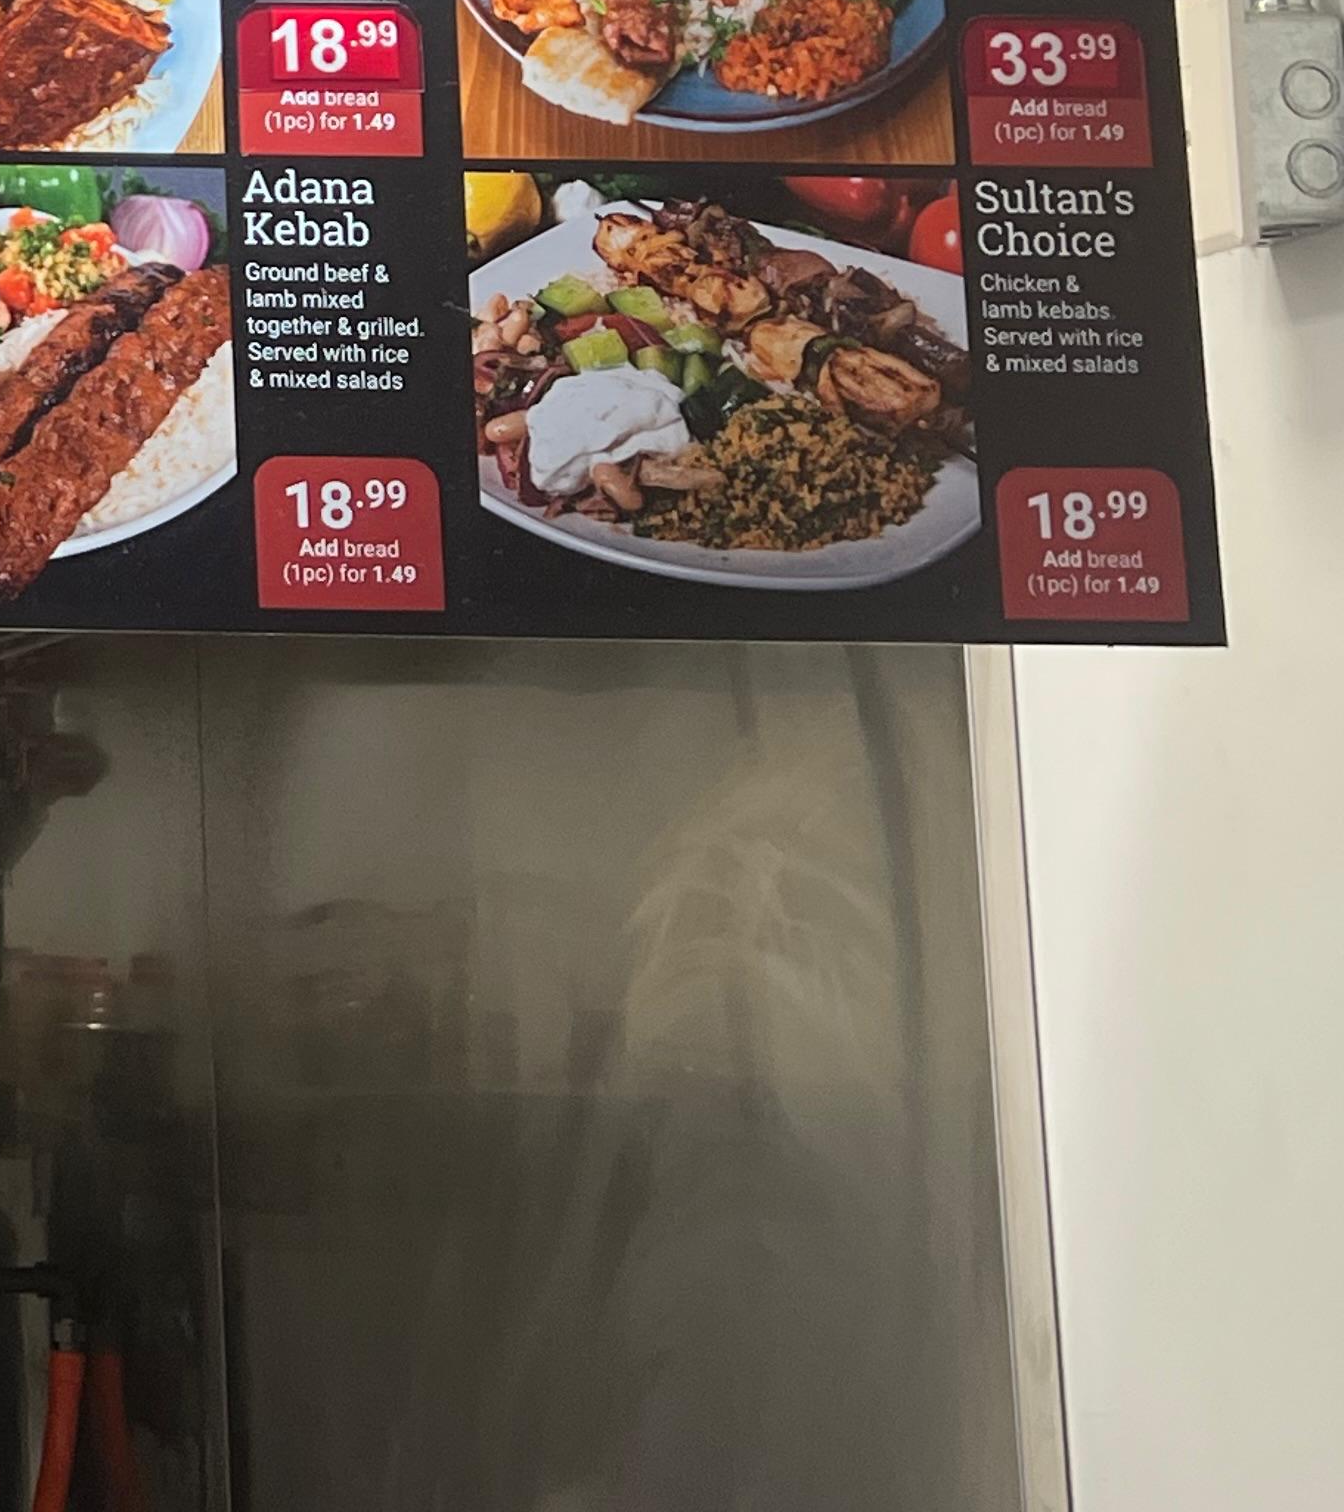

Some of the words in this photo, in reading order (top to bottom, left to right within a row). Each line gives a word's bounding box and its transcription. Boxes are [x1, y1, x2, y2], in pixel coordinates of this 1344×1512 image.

[271, 18, 398, 73] 18.99
[989, 32, 1116, 86] 33.99
[241, 168, 375, 205] Adana
[974, 179, 1135, 215] Sultan's
[242, 210, 370, 247] Kebab
[977, 221, 1116, 258] Choice
[980, 272, 1061, 293] Chicken
[1066, 274, 1080, 293] &
[981, 299, 1033, 320] lamb
[1036, 300, 1117, 321] kebabs.
[983, 326, 1053, 346] Served
[1058, 327, 1102, 346] with
[1106, 329, 1143, 348] rice
[986, 353, 1001, 373] &
[1005, 353, 1067, 373] mixed
[1072, 354, 1139, 374] salads
[285, 479, 406, 530] 18.99
[1027, 490, 1147, 540] 18.99
[298, 538, 339, 557] Add
[343, 538, 400, 558] bread
[283, 561, 334, 587] (1pc)
[339, 563, 368, 583] for
[372, 565, 417, 584] 1.49
